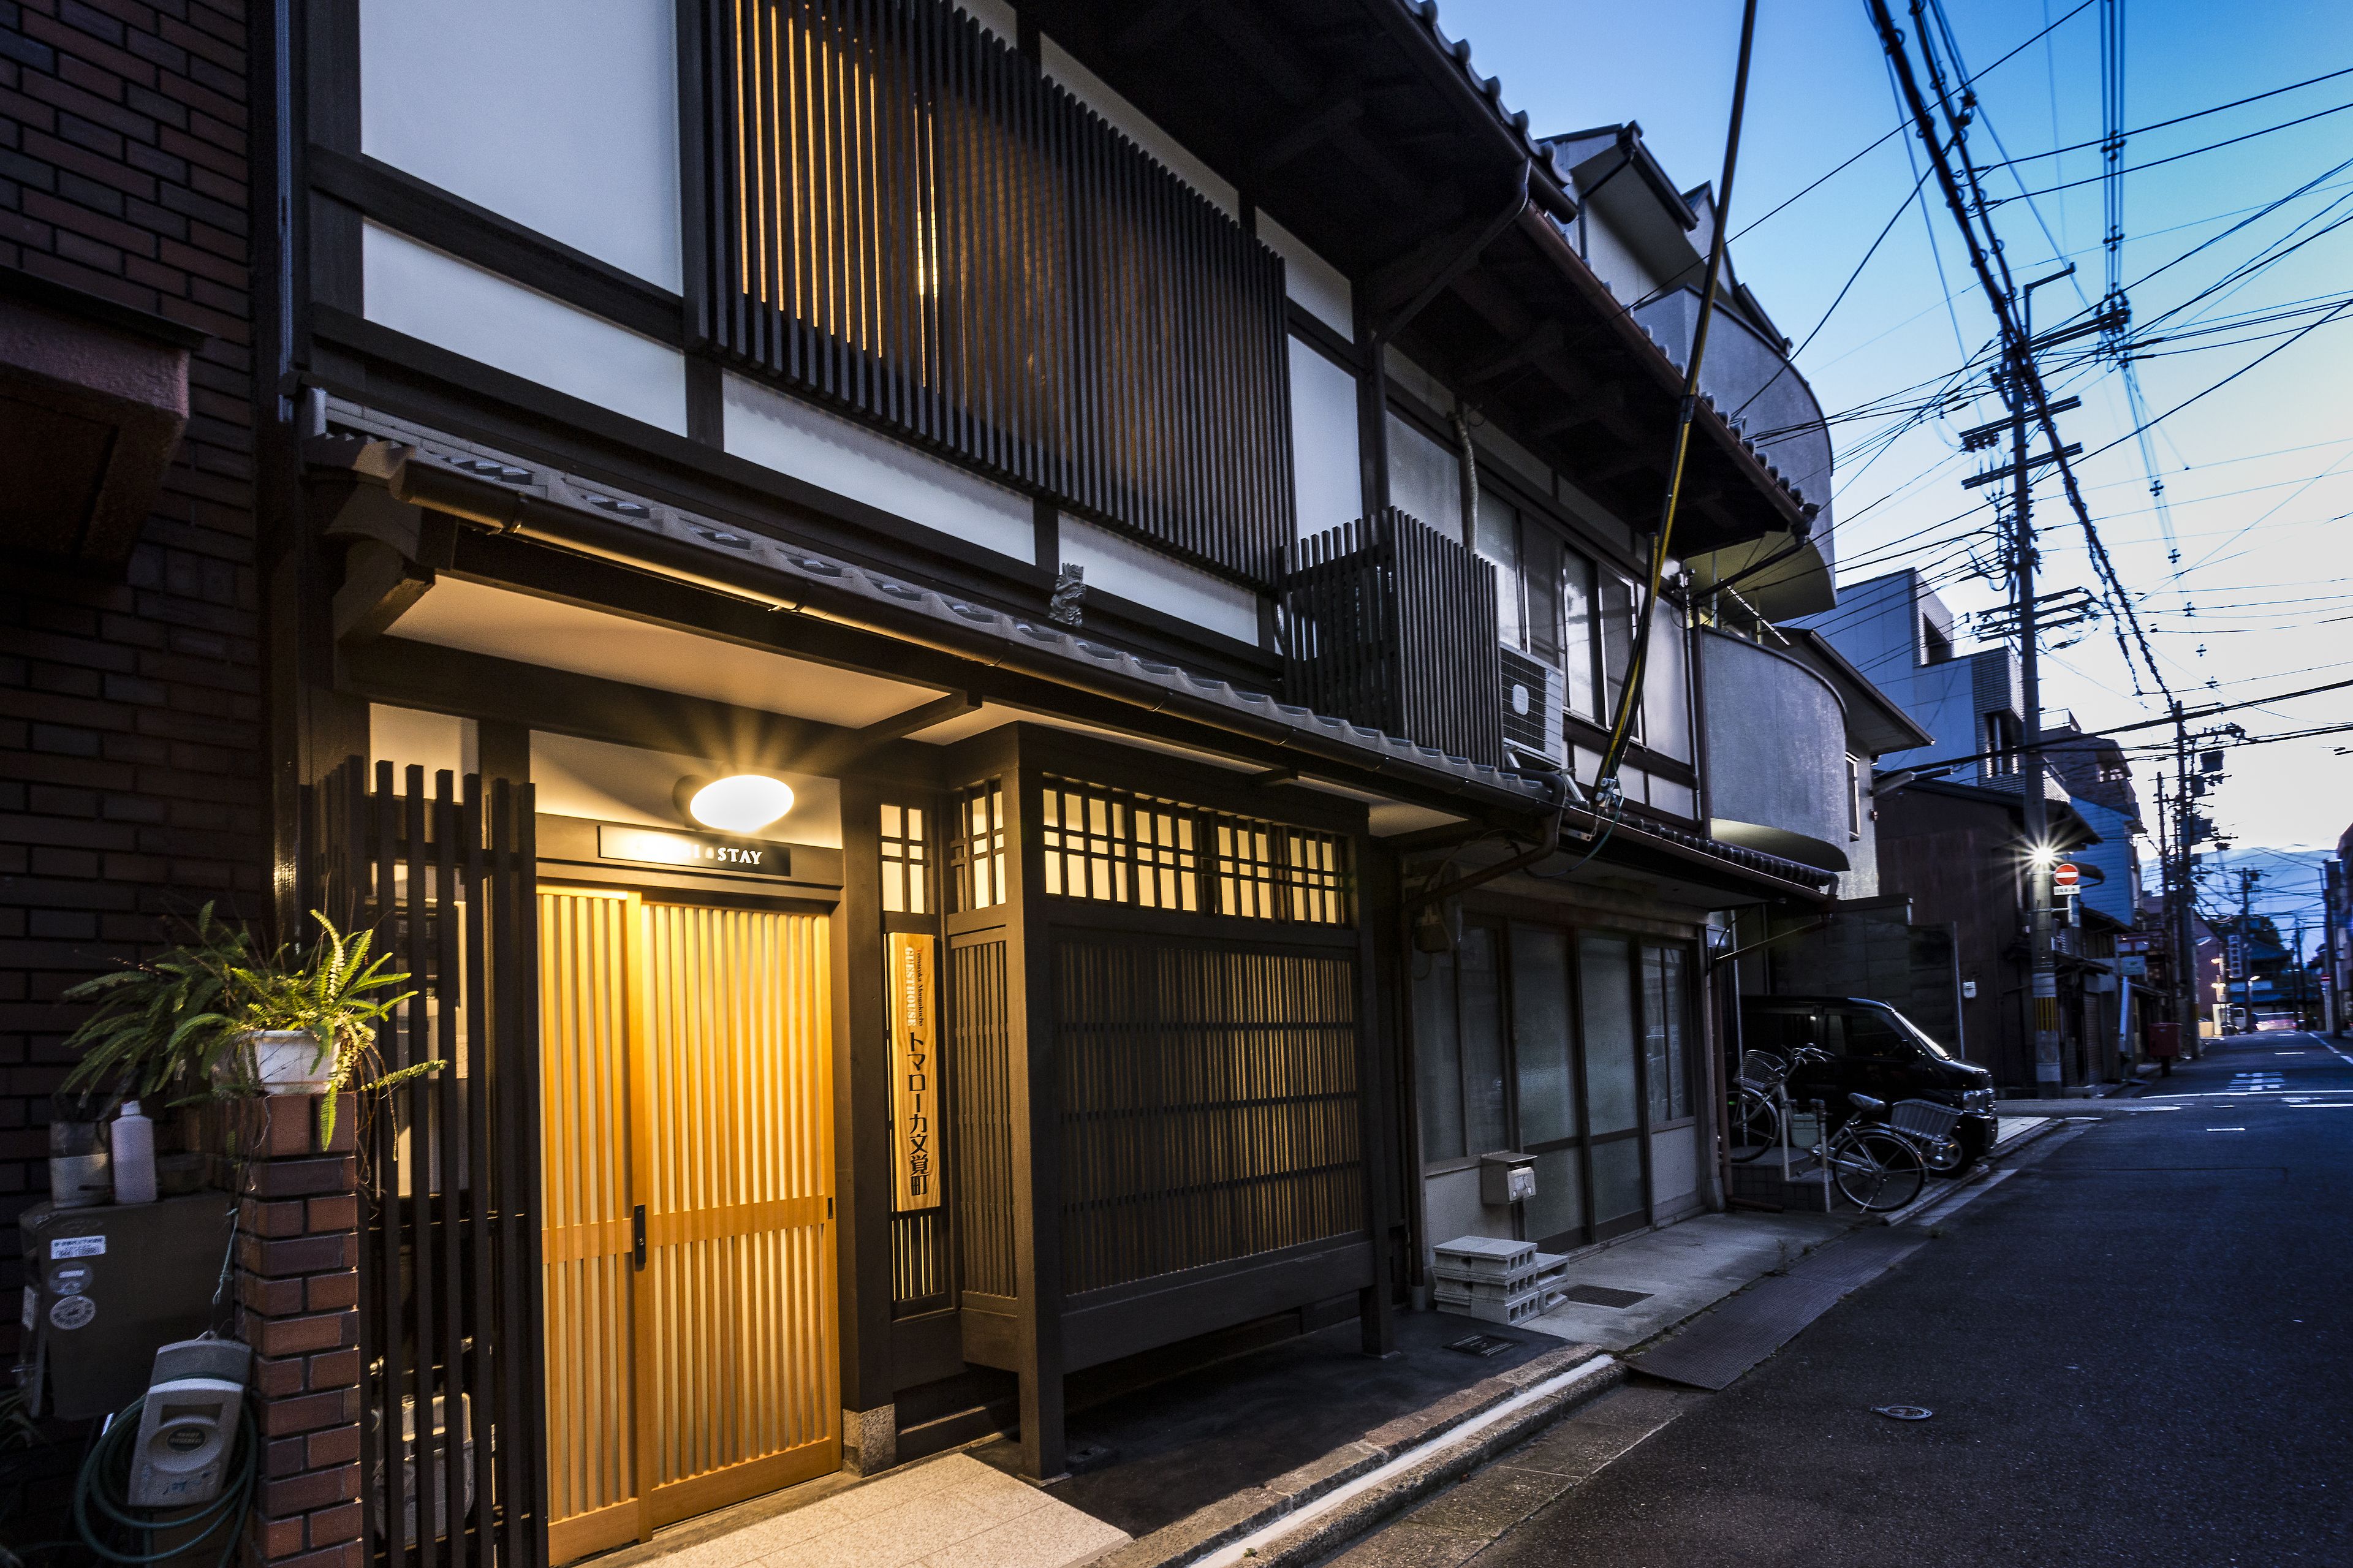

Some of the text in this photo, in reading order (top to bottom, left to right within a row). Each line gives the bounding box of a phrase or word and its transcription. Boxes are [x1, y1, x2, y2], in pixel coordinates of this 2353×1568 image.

[718, 847, 762, 865] STAY
[906, 947, 917, 1026] GUESTHOUSE
[907, 1032, 929, 1196] トマローカ文覚町
